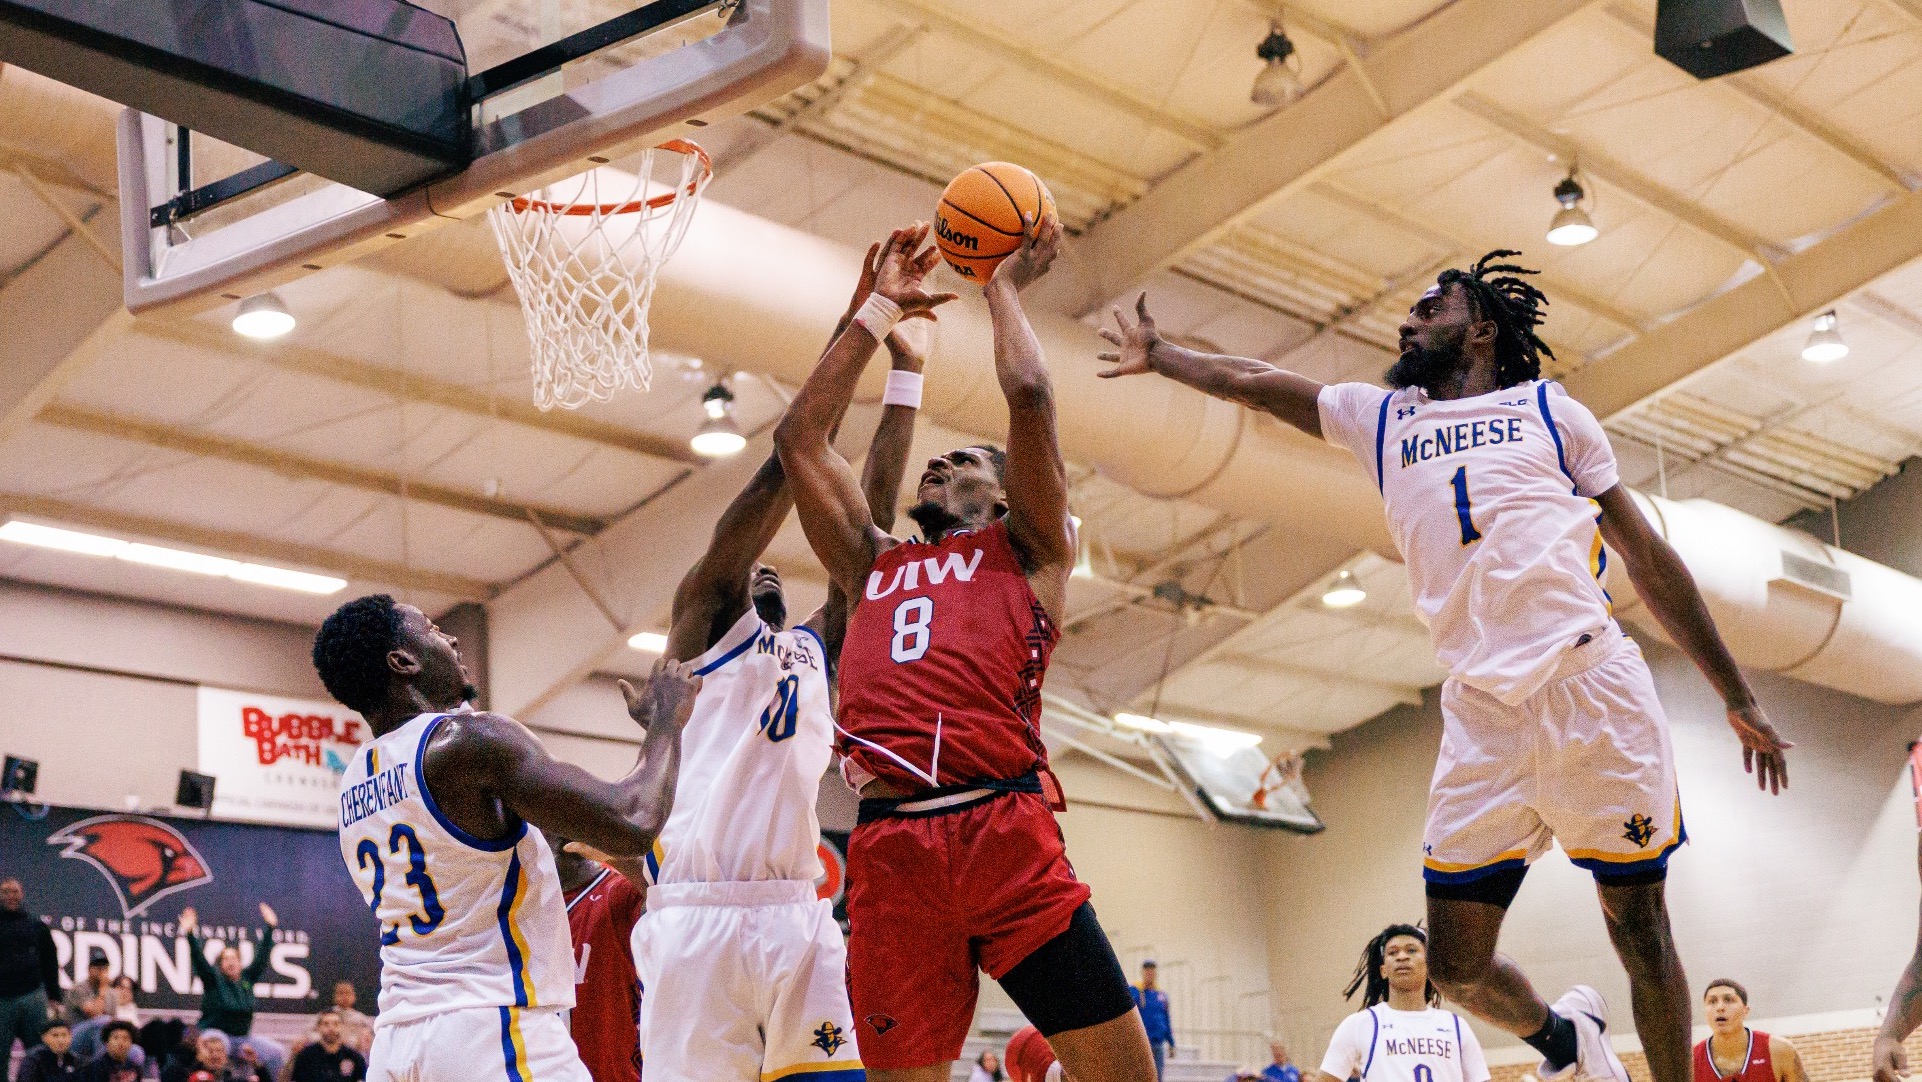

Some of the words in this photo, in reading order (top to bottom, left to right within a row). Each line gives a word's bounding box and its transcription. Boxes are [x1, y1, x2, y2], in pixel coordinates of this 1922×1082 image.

[1401, 418, 1523, 469] McNEESE
[1450, 464, 1483, 549] 1
[866, 548, 984, 600] UIW
[890, 595, 935, 665] 8
[242, 706, 361, 746] BUBBLE
[258, 738, 321, 765] BATH
[340, 762, 408, 829] CHERENFANT
[356, 822, 446, 946] 23
[1386, 1037, 1452, 1059] McNEESE
